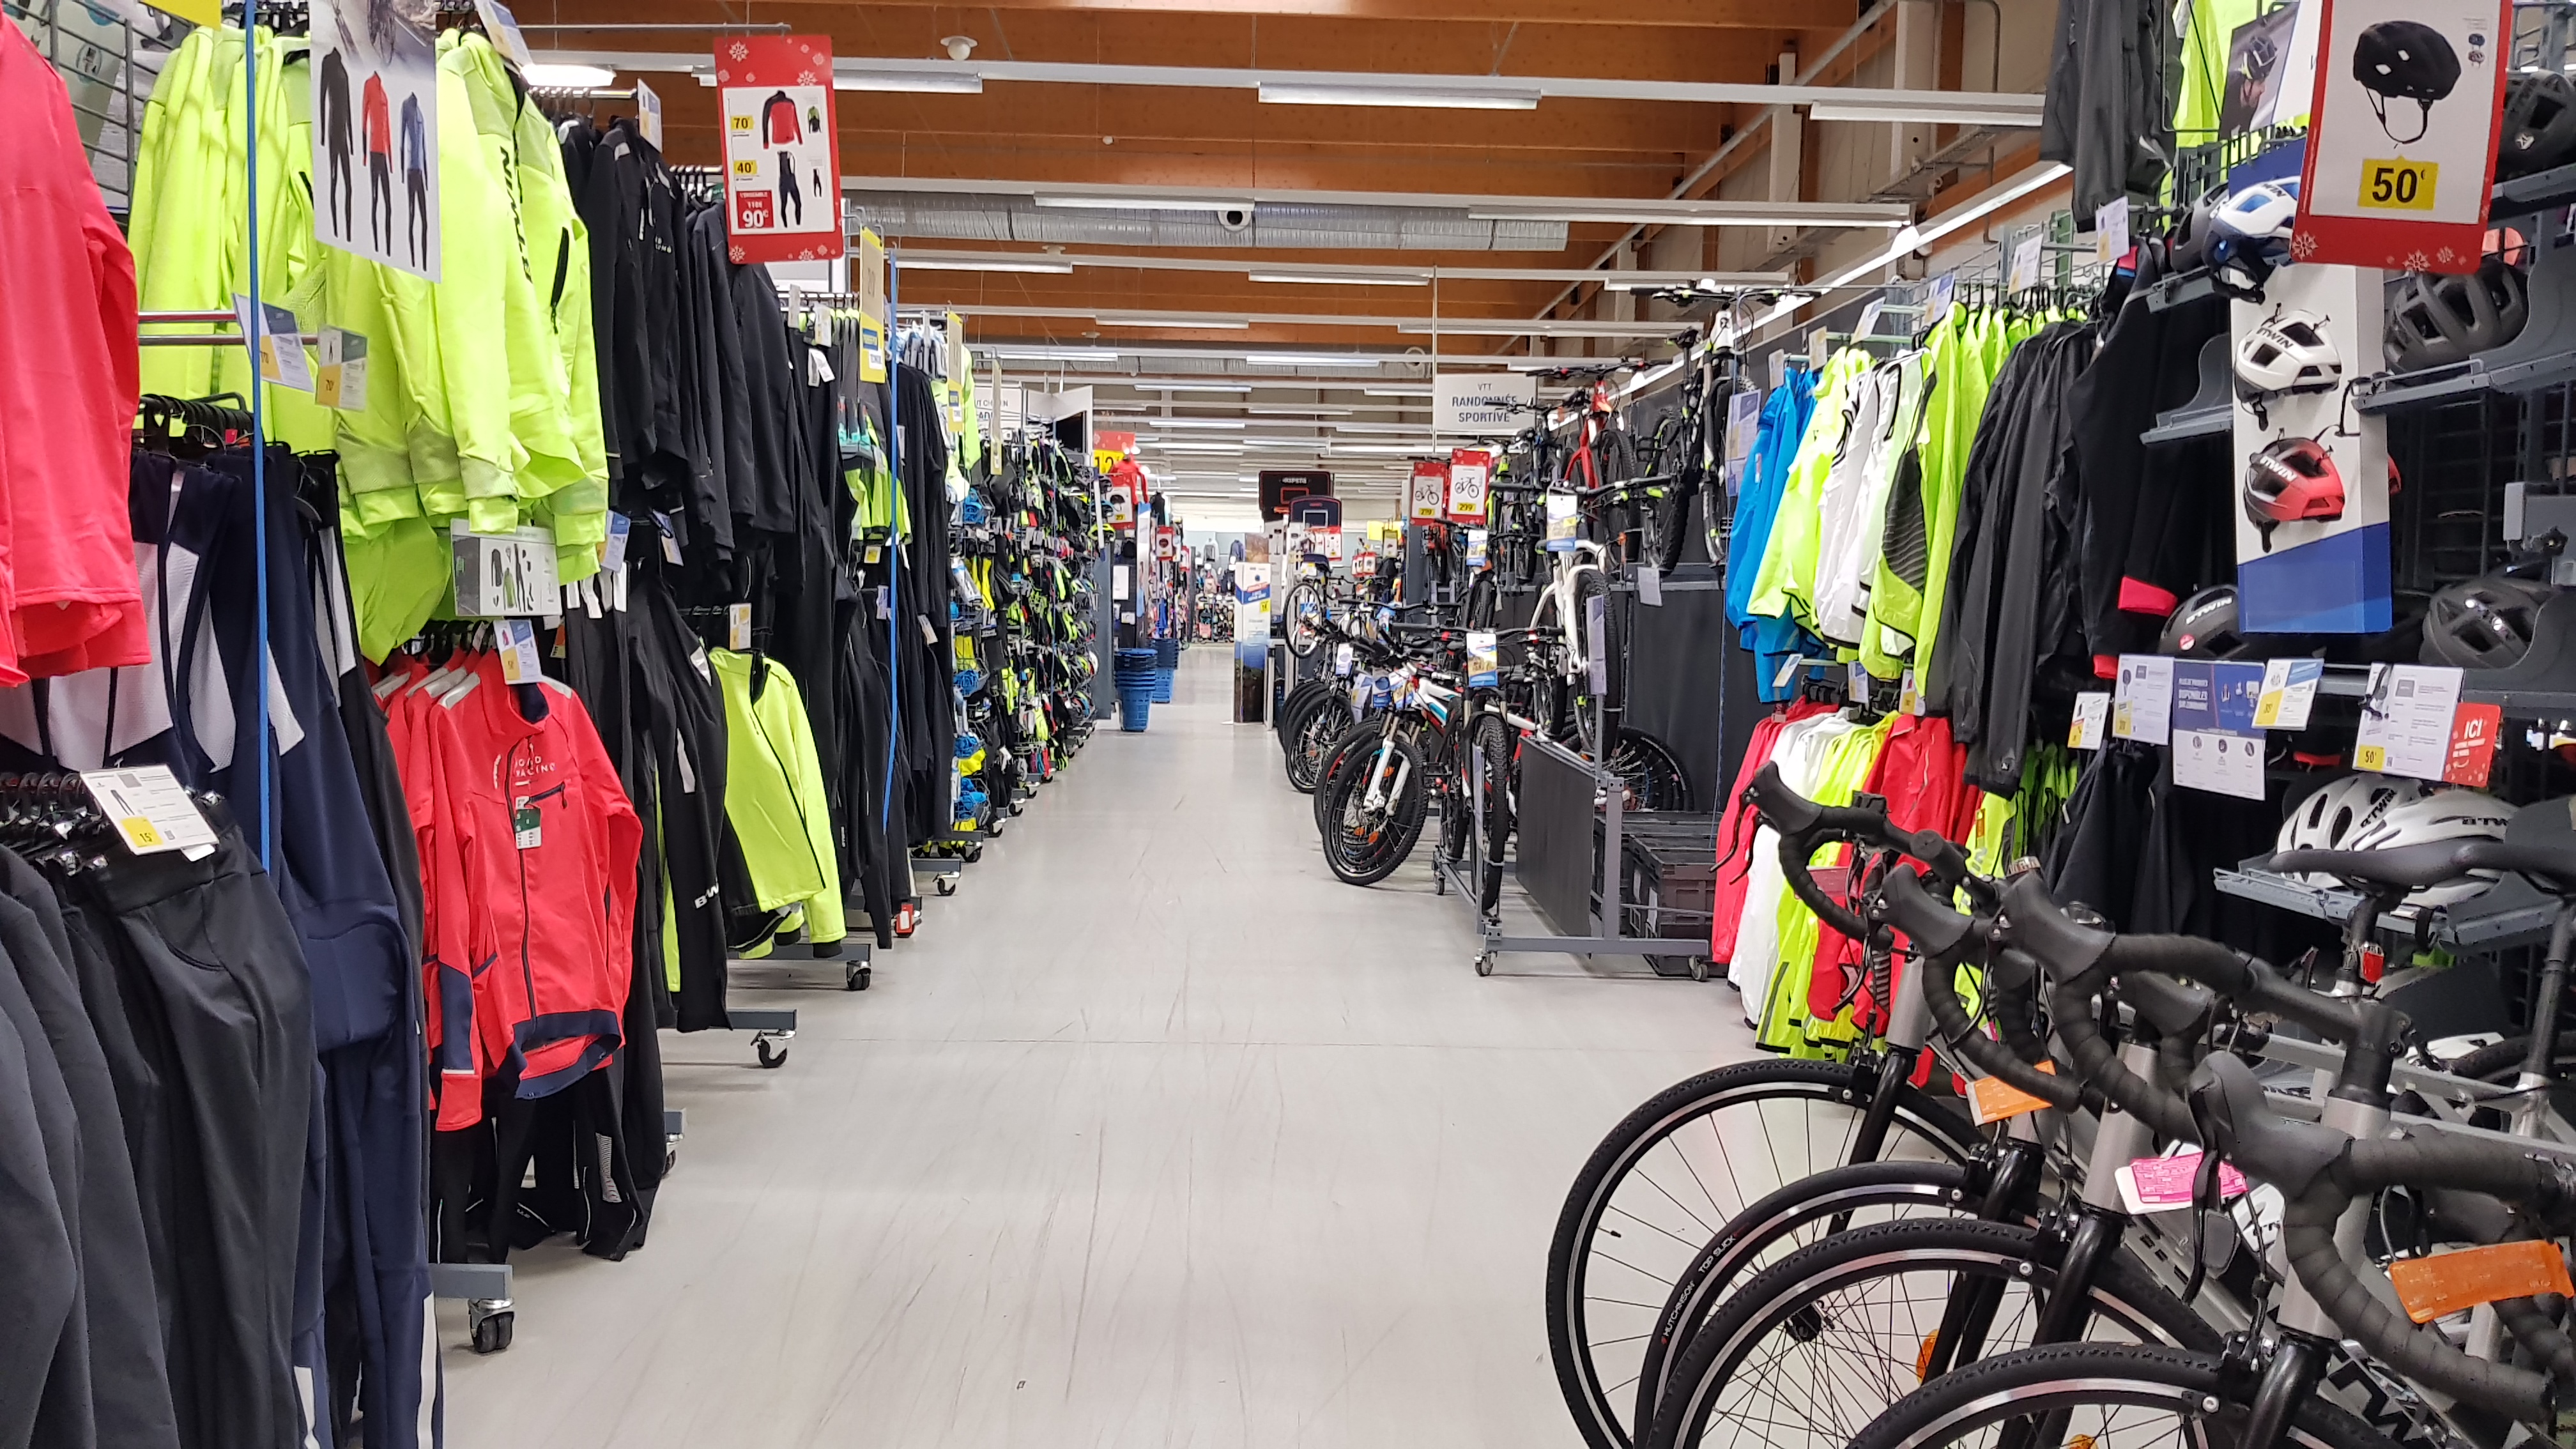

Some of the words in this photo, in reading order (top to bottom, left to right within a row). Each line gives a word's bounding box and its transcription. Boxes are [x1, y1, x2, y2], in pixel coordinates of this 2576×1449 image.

[1459, 412, 1510, 423] SPORTIVE
[2464, 717, 2483, 739] ICI
[1698, 1255, 1714, 1274] TOP
